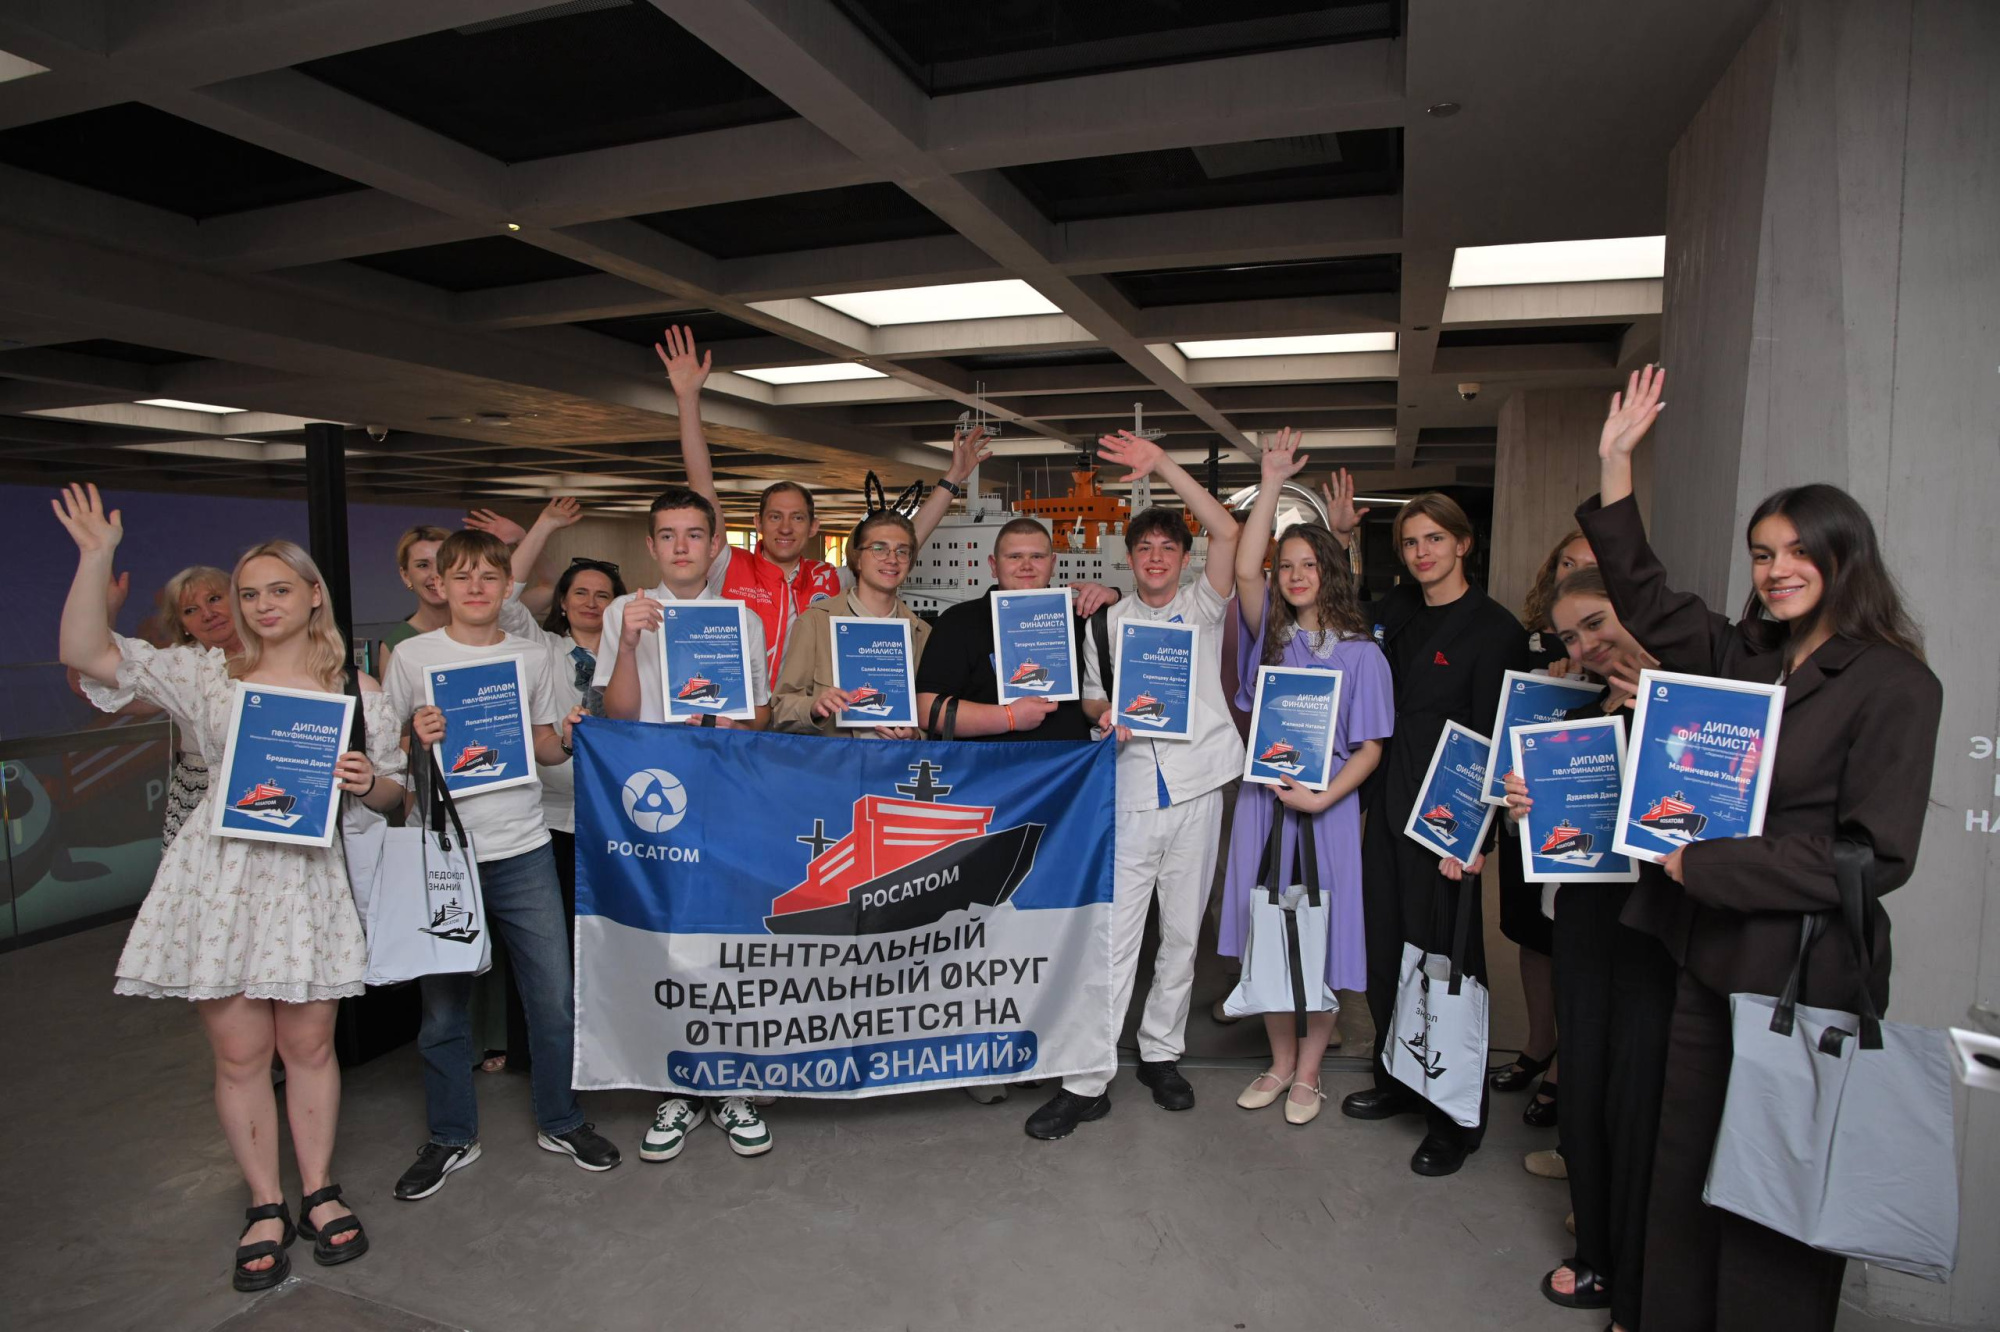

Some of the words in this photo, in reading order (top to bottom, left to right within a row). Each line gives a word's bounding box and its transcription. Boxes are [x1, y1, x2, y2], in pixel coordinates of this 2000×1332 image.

[1020, 620, 1065, 629] ФИНАЛИСТА
[858, 647, 903, 655] ФИНАЛИСТА
[1142, 653, 1188, 664] ФИНАЛИСТА
[477, 682, 515, 696] ДИПЛОМ
[1281, 700, 1329, 710] ФИНАЛИСТА
[291, 722, 338, 735] ДИПЛОМ
[1703, 721, 1760, 739] ДИПЛОМ
[271, 729, 336, 743] ПОЛУФИНАЛИСТА
[1677, 728, 1757, 752] ФИНАЛИСТА
[1968, 736, 2000, 759] Э
[266, 754, 309, 765] Бредихиной
[1570, 754, 1615, 767] ДИПЛОМ
[1552, 765, 1616, 775] ПОЛУФИНАЛИСТА
[1668, 762, 1720, 778] Маринчевой
[1720, 771, 1751, 785] Ульяне
[1566, 793, 1599, 802] Дудаевой
[607, 840, 700, 863] РОСАТОМ
[428, 871, 465, 880] ЛЕДОКОЛ
[428, 882, 461, 891] ЗНАНИЙ
[861, 865, 960, 911] РОСАТОМ
[720, 916, 985, 973] ЦЕНТРАЛЬНЫЙ
[654, 959, 930, 1015] ФЕДЕРАЛЬНЫЙ
[941, 957, 1048, 990] ОКРУГ
[685, 1001, 963, 1048] ОТПРАВЛЯЕТСЯ
[974, 997, 1022, 1026] НА
[869, 1034, 1032, 1080] ЗНАНИЙ»
